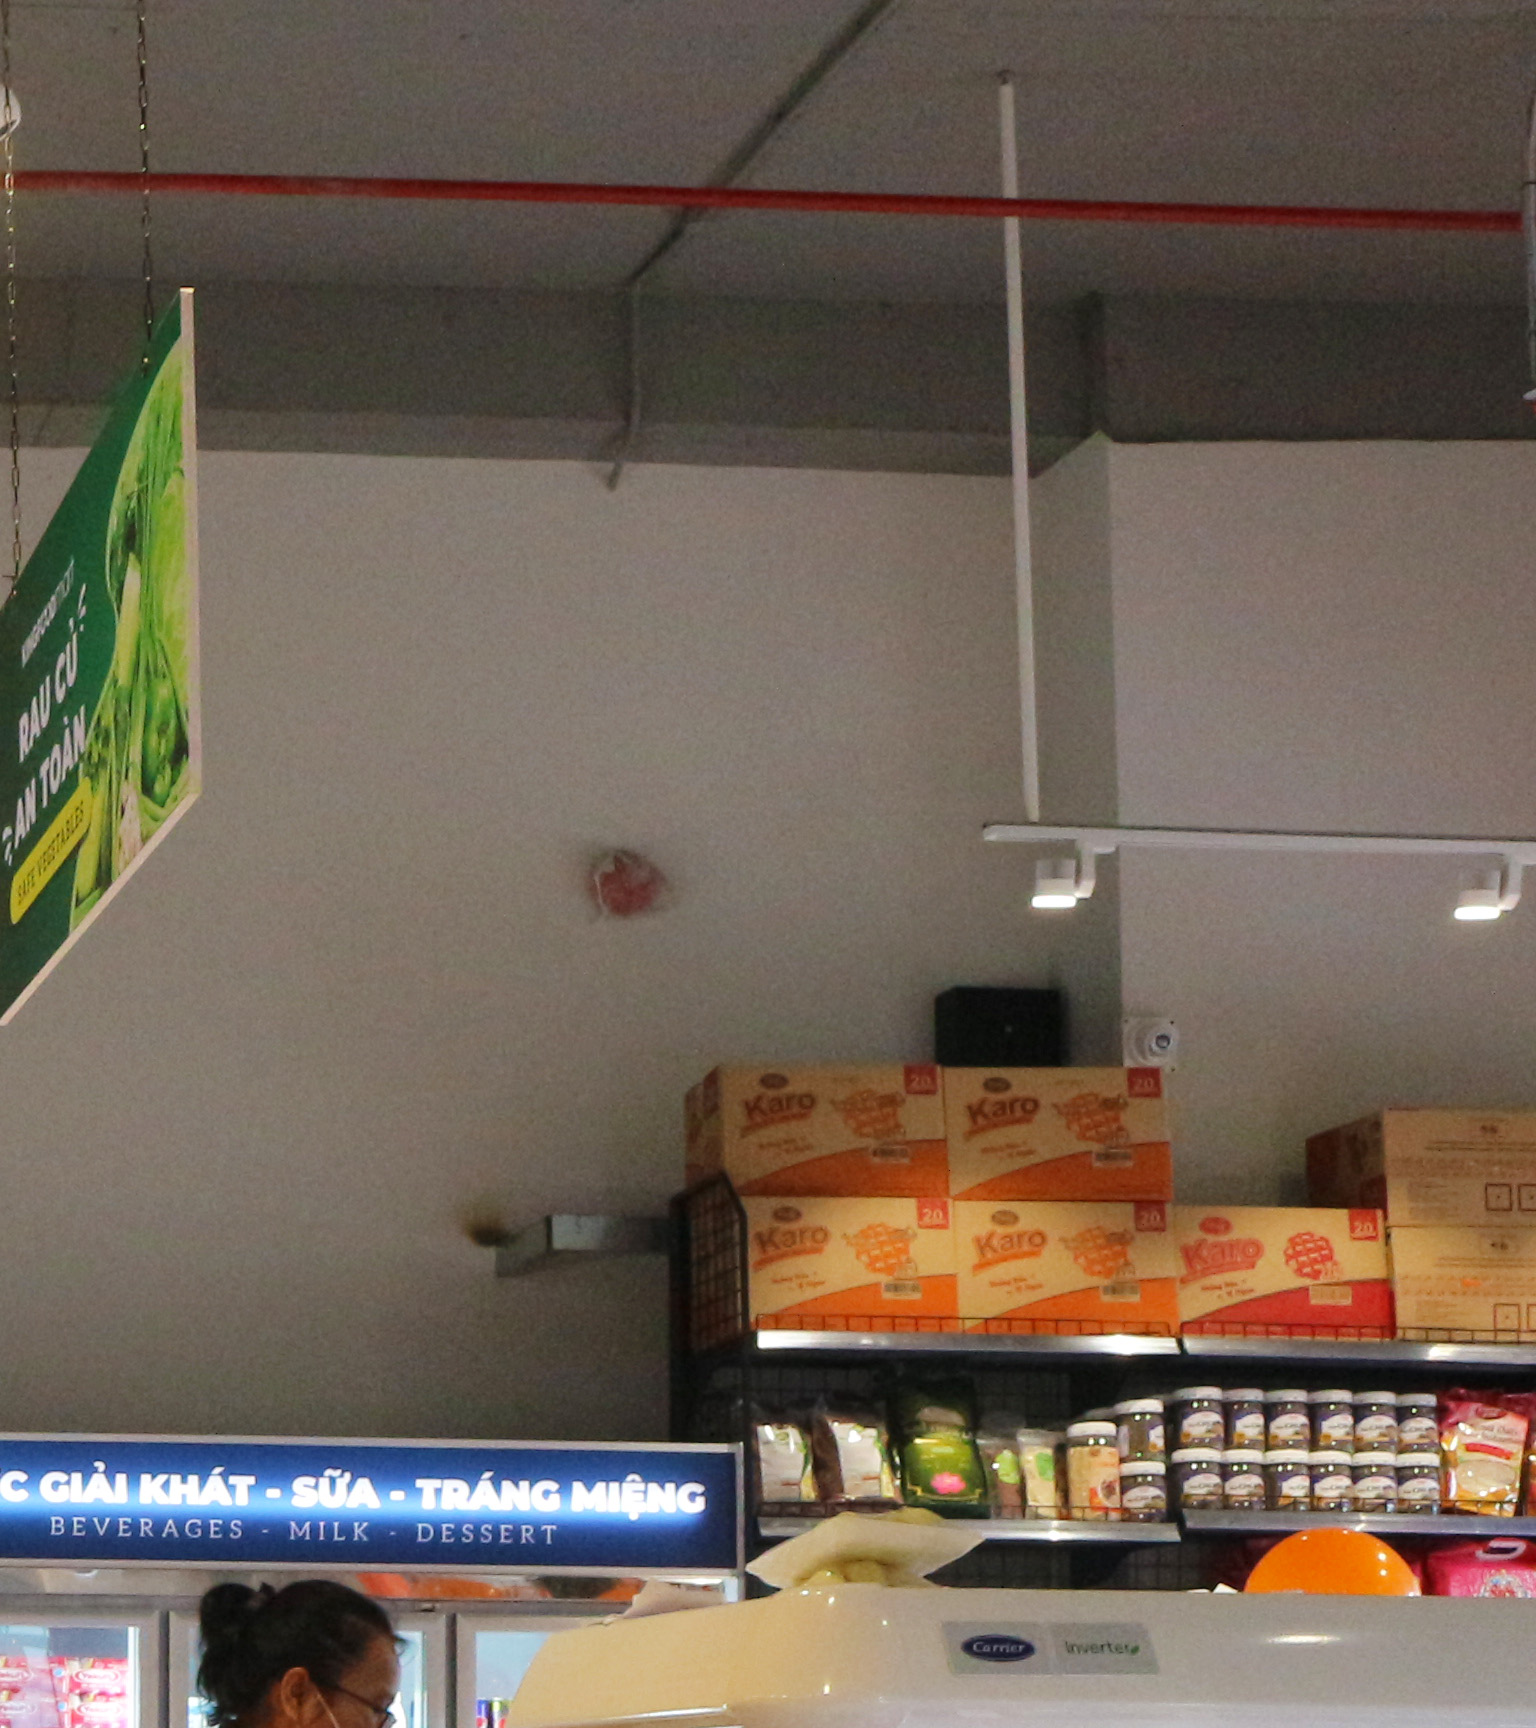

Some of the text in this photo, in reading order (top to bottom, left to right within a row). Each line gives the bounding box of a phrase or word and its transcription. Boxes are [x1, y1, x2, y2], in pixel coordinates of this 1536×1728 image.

[19, 617, 79, 763] RAU CỦ
[14, 704, 87, 849] AN TOÀN
[16, 799, 85, 907] SAFE VEGETABLES
[966, 1097, 1040, 1125] Karo
[754, 1225, 829, 1253] Karo
[972, 1229, 1048, 1257] Karo
[39, 1459, 129, 1504] GIẢI
[139, 1466, 257, 1506] KHÁT
[290, 1466, 382, 1510] SỮA
[415, 1469, 562, 1512] TRÁNG
[570, 1473, 707, 1521] MIỆNG
[49, 1516, 559, 1545] BEVERAGES MILK DESSERT
[972, 1640, 1026, 1655] Carrier
